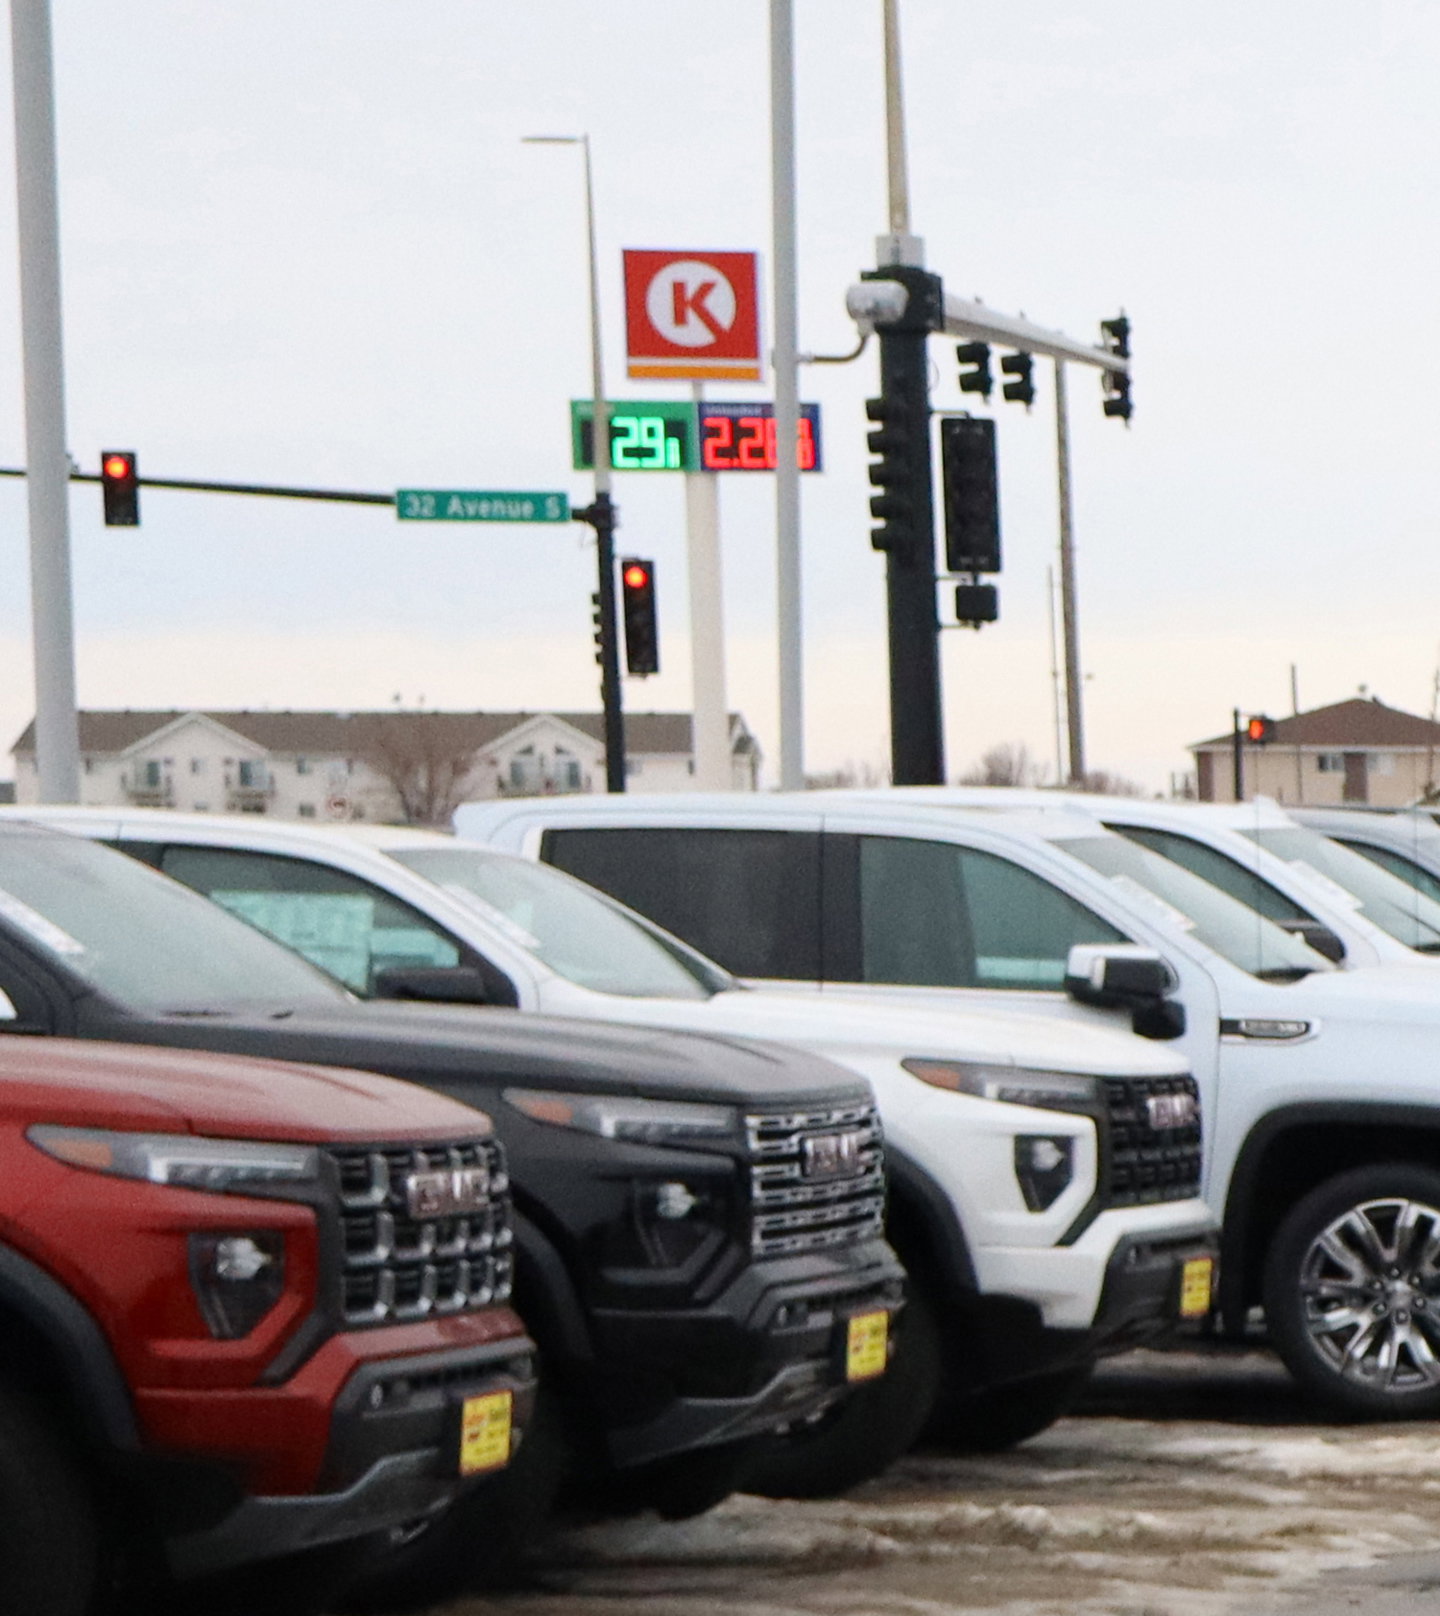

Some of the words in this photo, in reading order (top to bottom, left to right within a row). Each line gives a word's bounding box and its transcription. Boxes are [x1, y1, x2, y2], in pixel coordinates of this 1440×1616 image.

[405, 493, 436, 518] 32
[447, 494, 535, 518] Avenue
[545, 495, 561, 519] S
